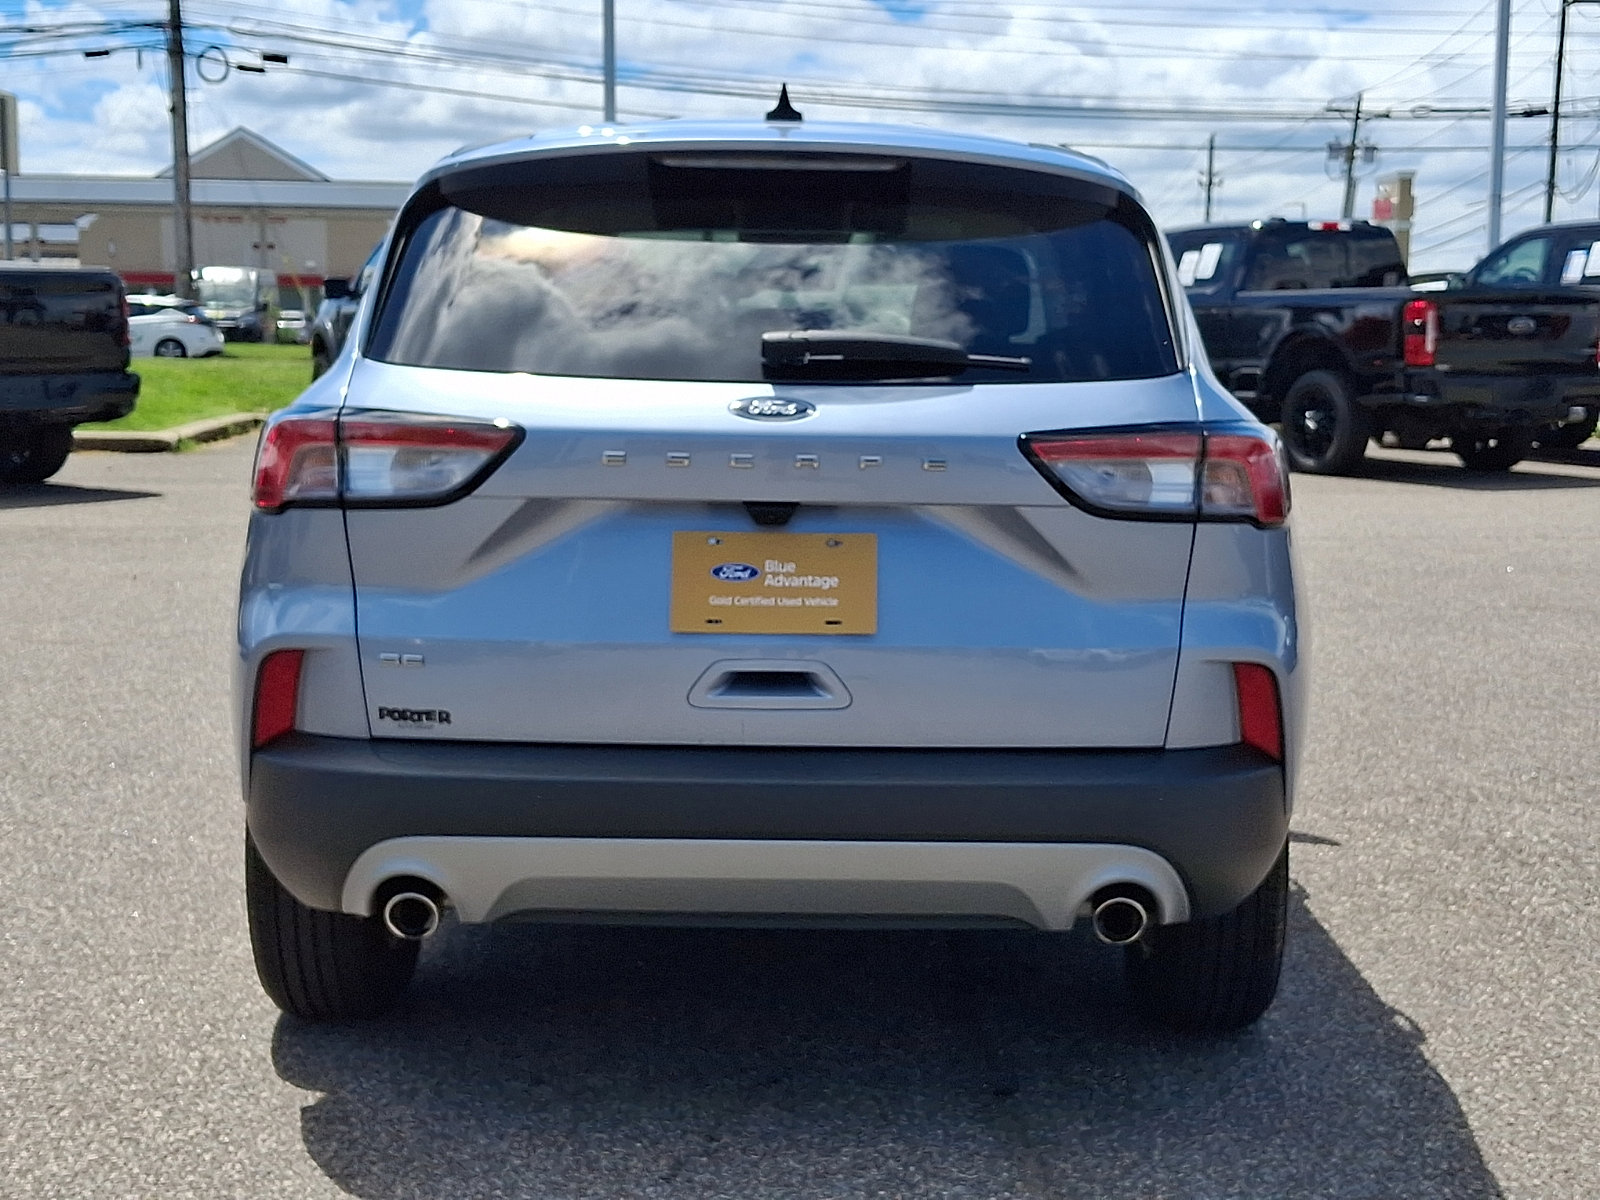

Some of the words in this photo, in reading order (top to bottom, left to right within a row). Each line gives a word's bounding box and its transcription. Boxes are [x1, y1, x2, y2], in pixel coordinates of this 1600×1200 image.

[601, 449, 947, 472] ESCAPE
[718, 563, 753, 580] Ford
[764, 559, 797, 573] Blue
[764, 573, 840, 590] Advantage
[709, 595, 733, 606] Gold
[734, 595, 776, 606] Certified
[778, 596, 803, 606] Used
[804, 597, 839, 607] Vehicle
[380, 652, 424, 668] SE
[378, 706, 451, 724] PORTER
